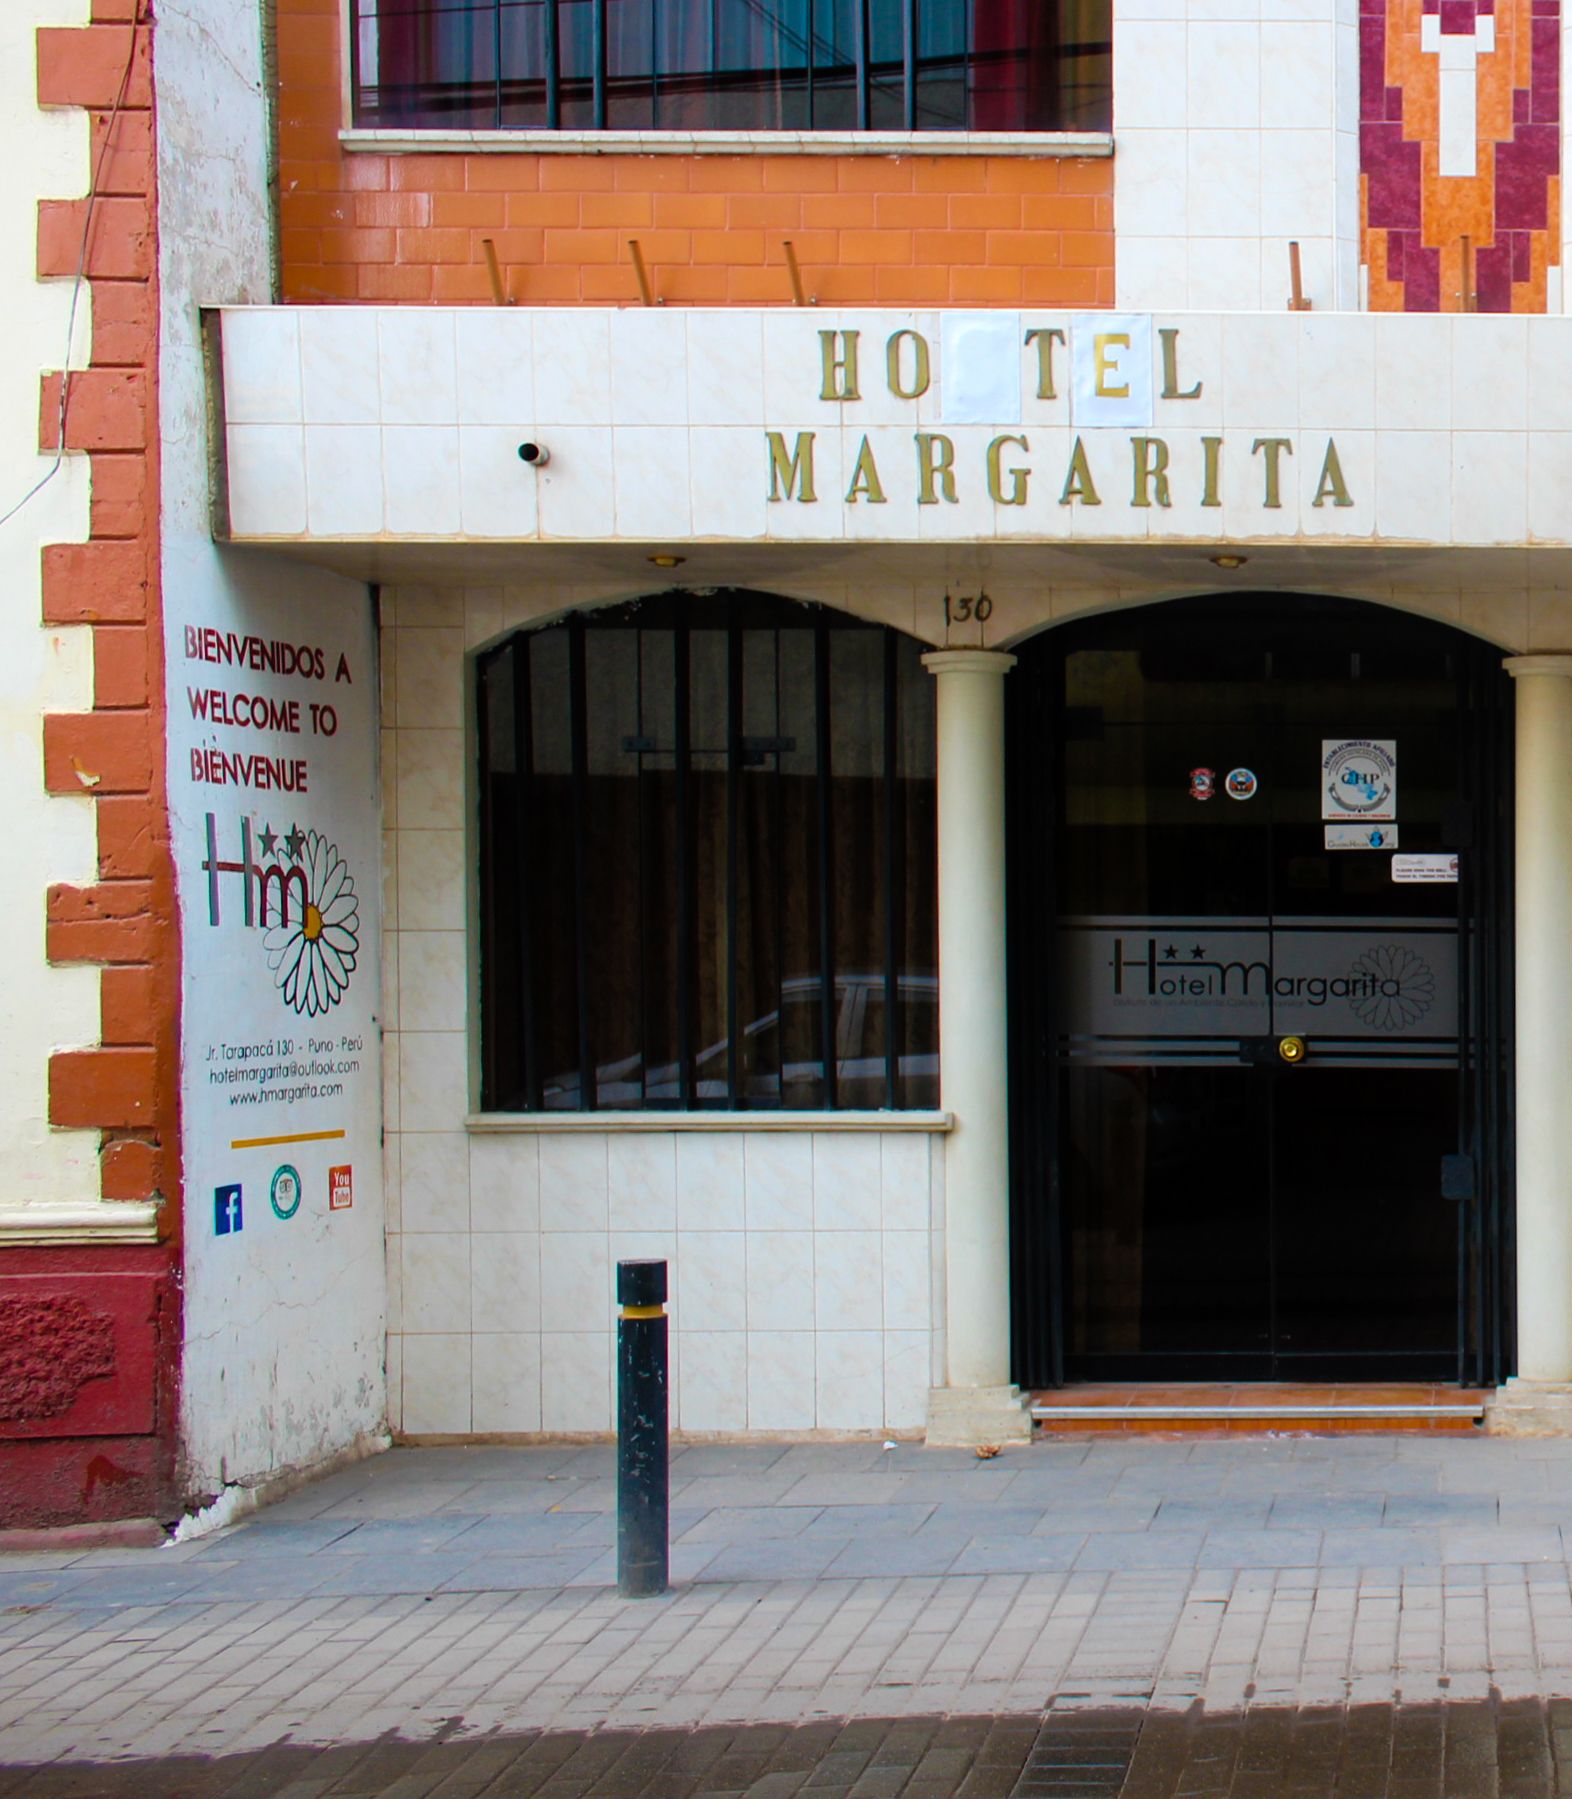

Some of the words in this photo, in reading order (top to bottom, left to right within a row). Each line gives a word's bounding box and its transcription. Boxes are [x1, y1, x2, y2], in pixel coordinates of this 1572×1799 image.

[817, 328, 1203, 401] HOTEL
[765, 430, 1355, 509] MARGARITA
[943, 593, 993, 628] 130
[184, 624, 326, 681] BIENVENIDOS
[335, 652, 353, 685] A
[186, 685, 301, 734] WELCOME
[309, 703, 338, 737] TO
[190, 747, 308, 794] BIENVENUE
[1108, 939, 1213, 996] Hotel
[205, 1044, 219, 1061] Jr.
[220, 1039, 274, 1062] Tarapacá
[277, 1039, 295, 1057] 130
[308, 1038, 334, 1053] Puno
[341, 1034, 363, 1051] Perú
[209, 1060, 360, 1085] hotelmargarita@outlook.com
[229, 1083, 343, 1106] www.hmargarita.com
[334, 1172, 350, 1187] You
